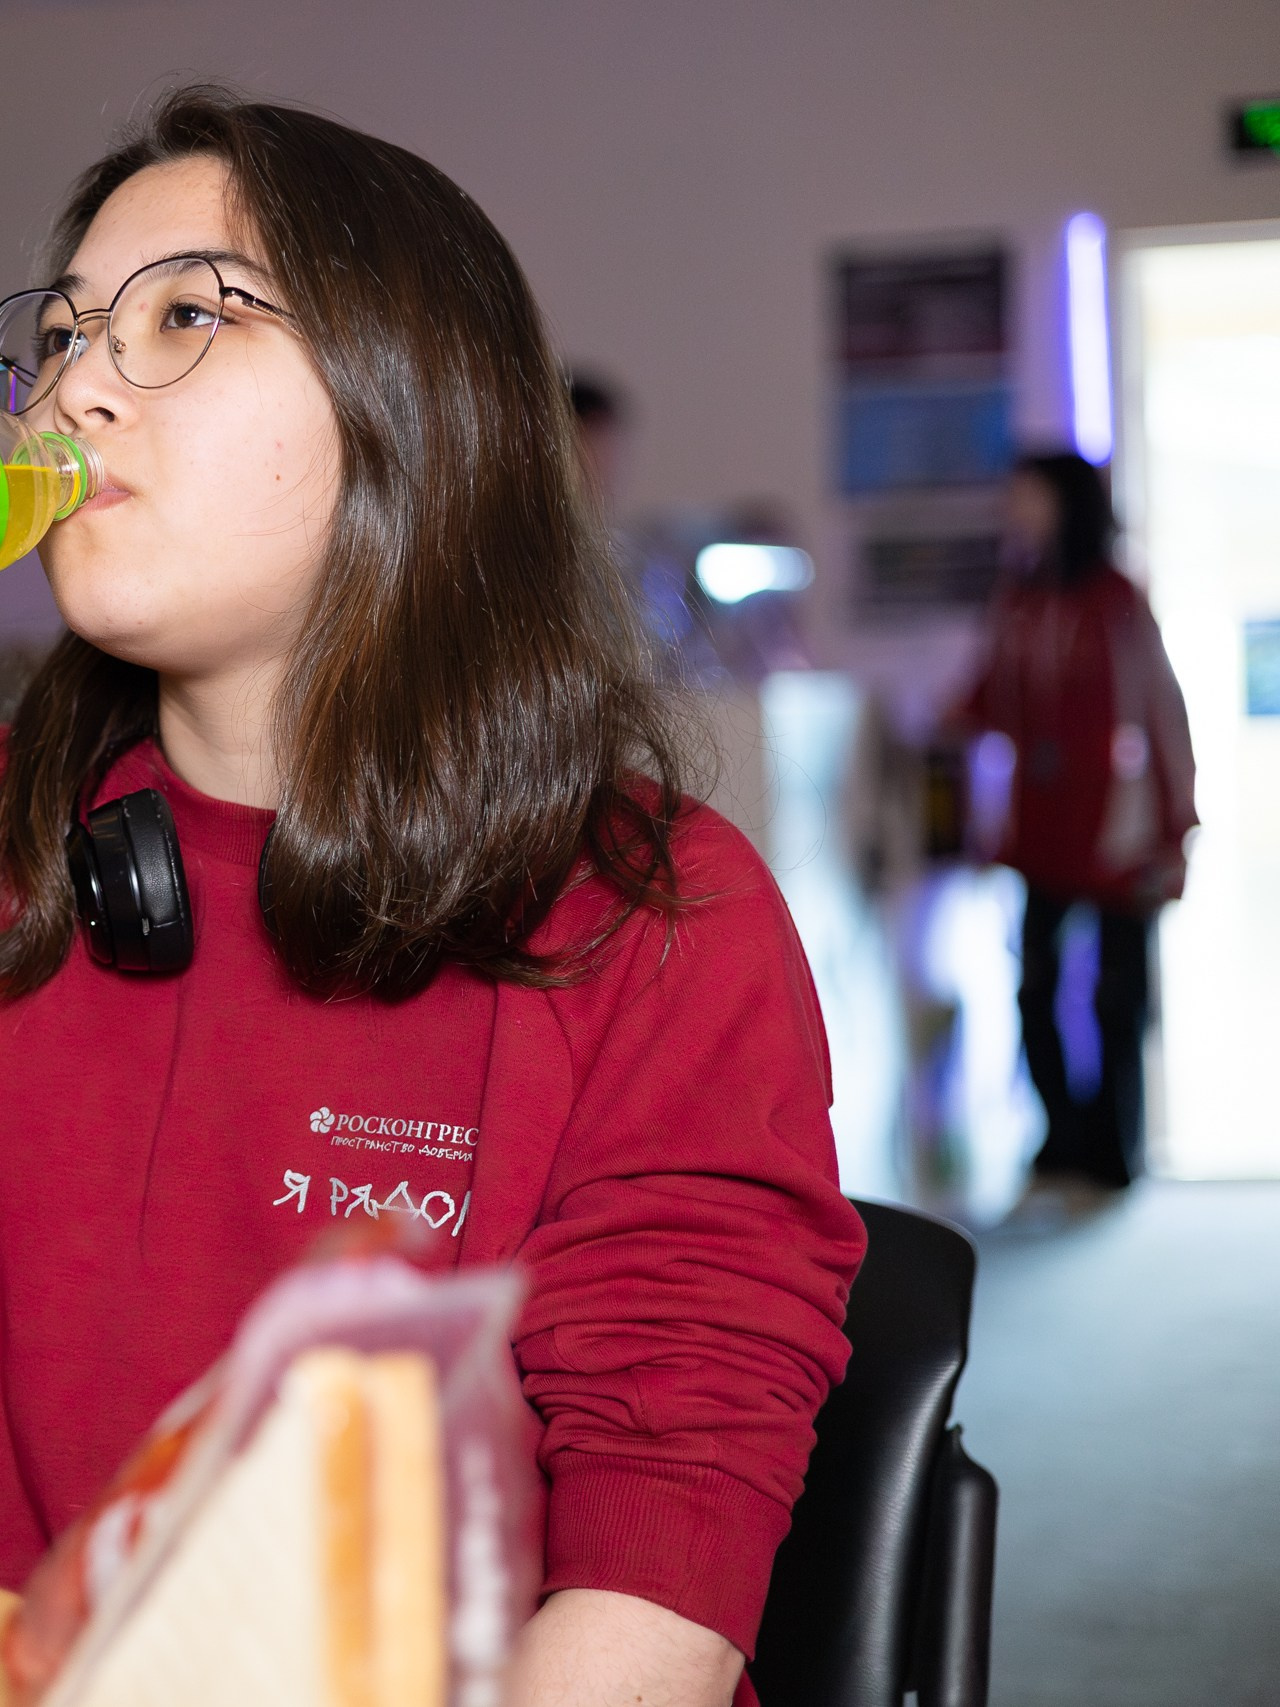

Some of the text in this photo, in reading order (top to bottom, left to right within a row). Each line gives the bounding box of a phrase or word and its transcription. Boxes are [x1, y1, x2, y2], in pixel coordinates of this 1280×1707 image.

[335, 1113, 480, 1146] РОСКОНГРЕС
[330, 1135, 473, 1162] ПРОСТРАНСТВО ДОВЕРИЯ
[273, 1168, 312, 1213] Я
